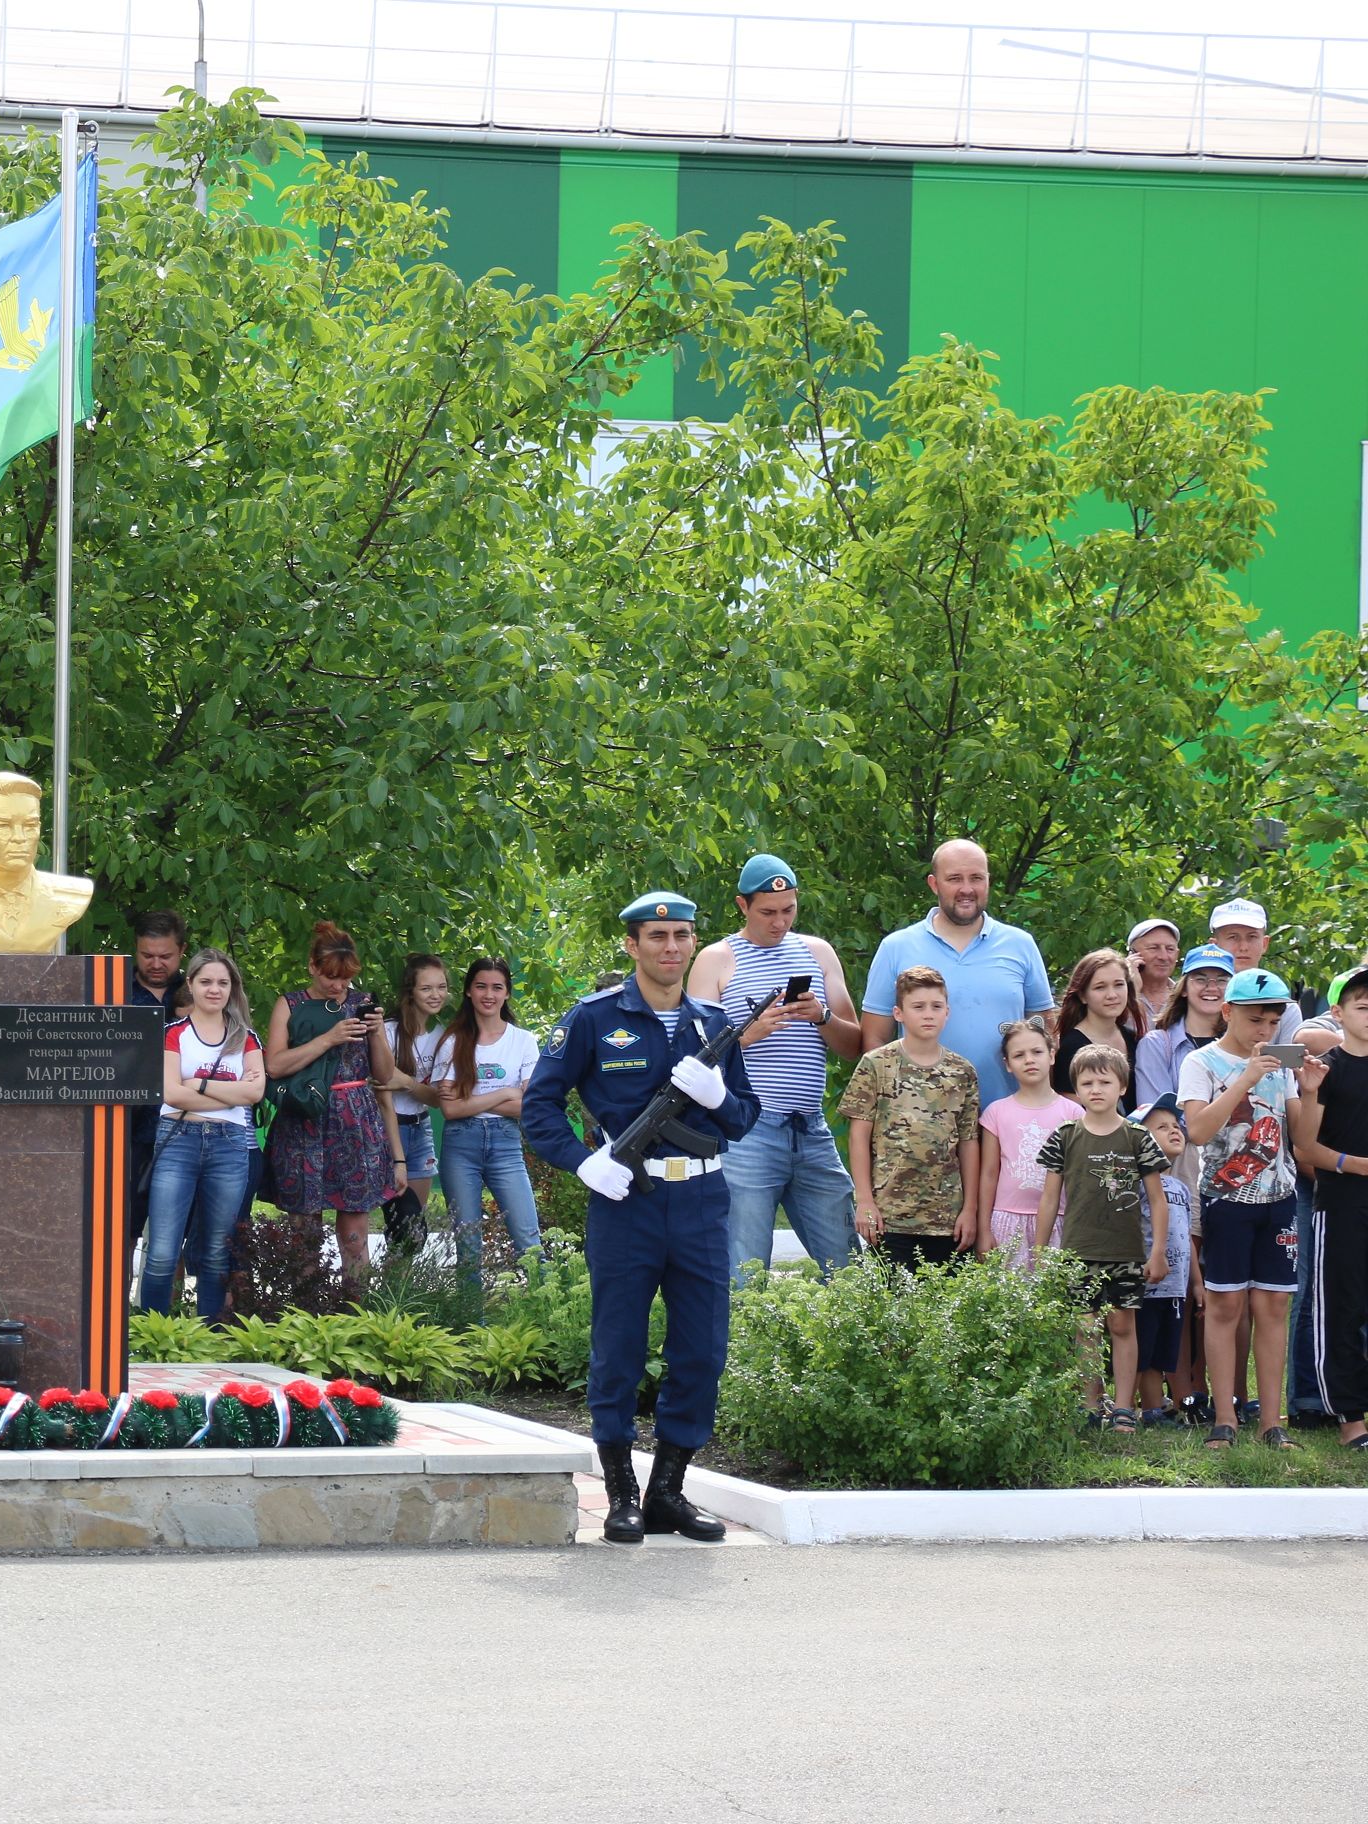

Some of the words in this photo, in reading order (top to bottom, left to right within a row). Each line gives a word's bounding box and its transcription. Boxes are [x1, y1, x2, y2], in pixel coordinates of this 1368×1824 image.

[16, 1008, 96, 1024] Десантник
[100, 1008, 123, 1023] №1
[0, 1028, 33, 1043] Герой
[36, 1028, 103, 1041] Советского
[106, 1029, 143, 1041] Союза
[29, 1048, 73, 1060] генерал
[76, 1048, 113, 1060] армии
[26, 1066, 116, 1081] МАРГЕЛОВ
[58, 1086, 149, 1100] Филиппович
